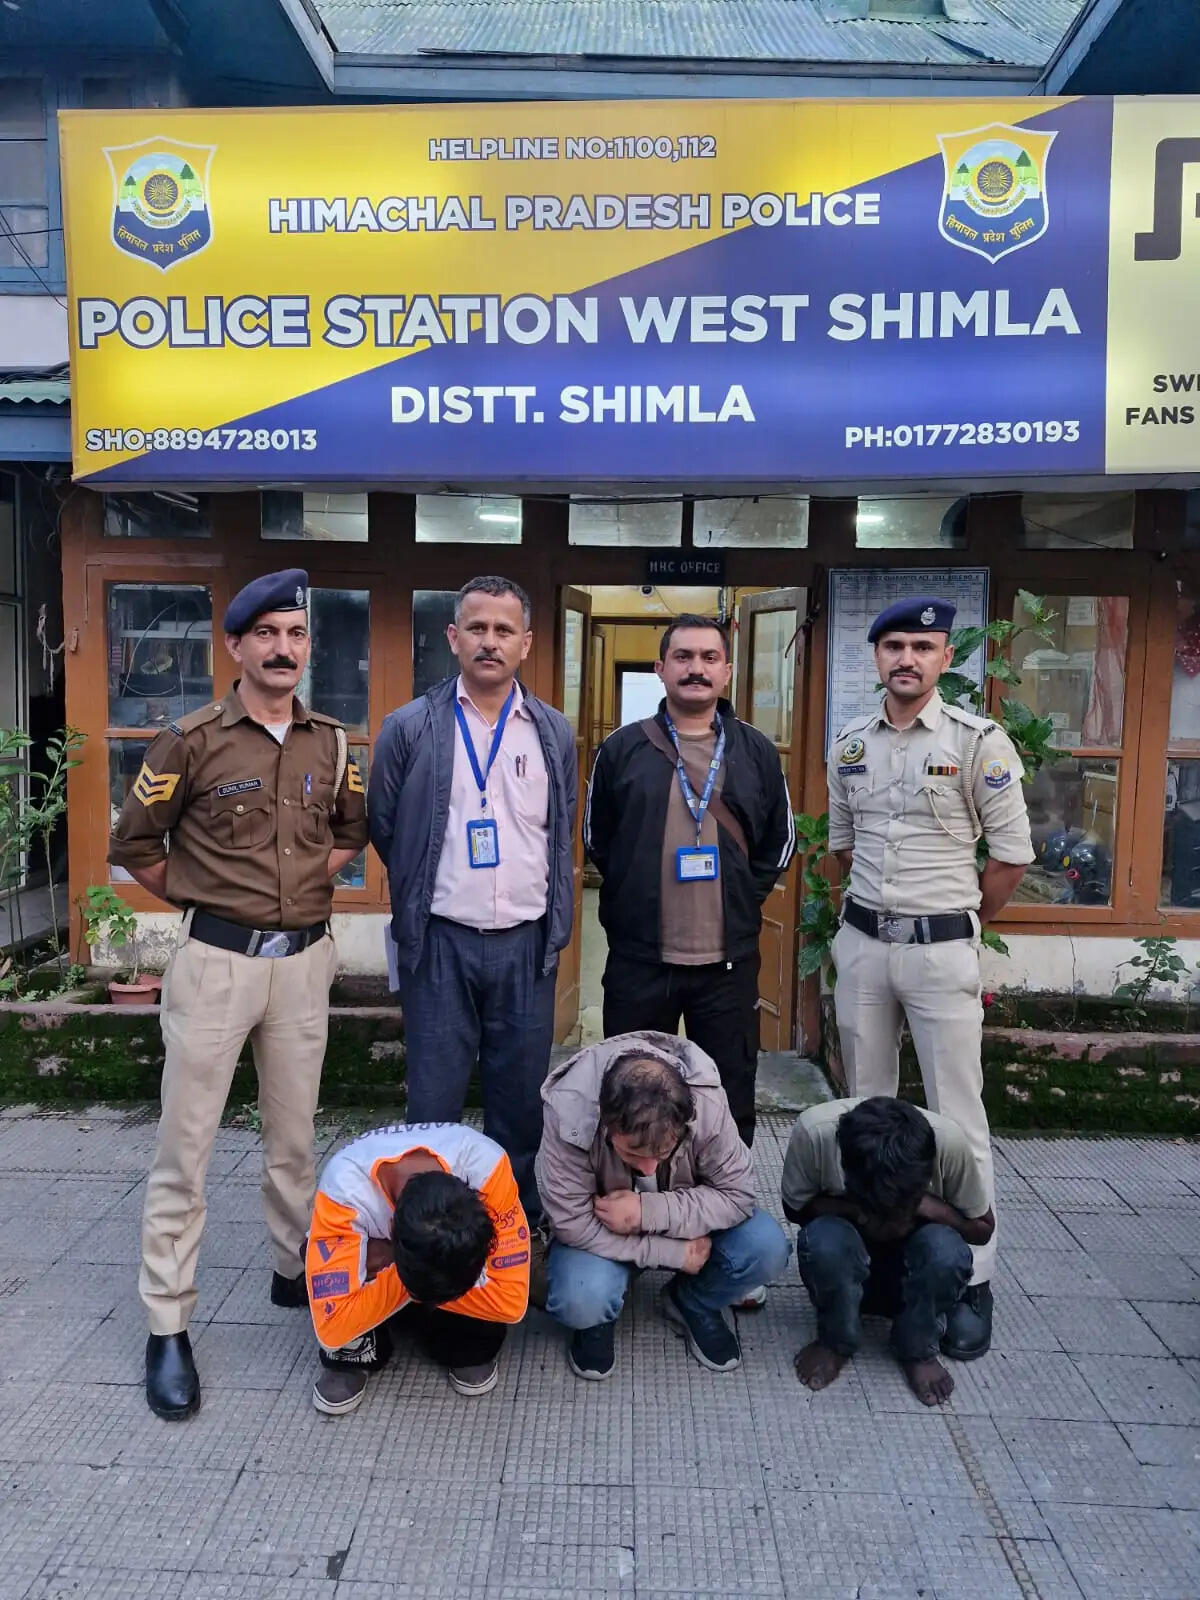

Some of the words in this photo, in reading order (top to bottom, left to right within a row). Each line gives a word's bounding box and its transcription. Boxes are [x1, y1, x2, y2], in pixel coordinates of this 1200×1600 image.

[429, 138, 559, 161] HELPLINE
[565, 135, 717, 161] NO:1100,112
[269, 196, 496, 234] HIMACHAL
[505, 194, 711, 231] PRADESH
[722, 191, 881, 227] POLICE
[78, 296, 310, 349] POLICE
[323, 294, 599, 348] STATION
[619, 294, 810, 344] WEST
[827, 288, 1082, 342] SHIMLA
[391, 386, 544, 425] DISTT.
[559, 384, 756, 425] SHIMLA
[1125, 406, 1195, 426] FANS
[85, 428, 319, 453] SHO:8894728013
[845, 420, 1081, 449] PH:01772830193
